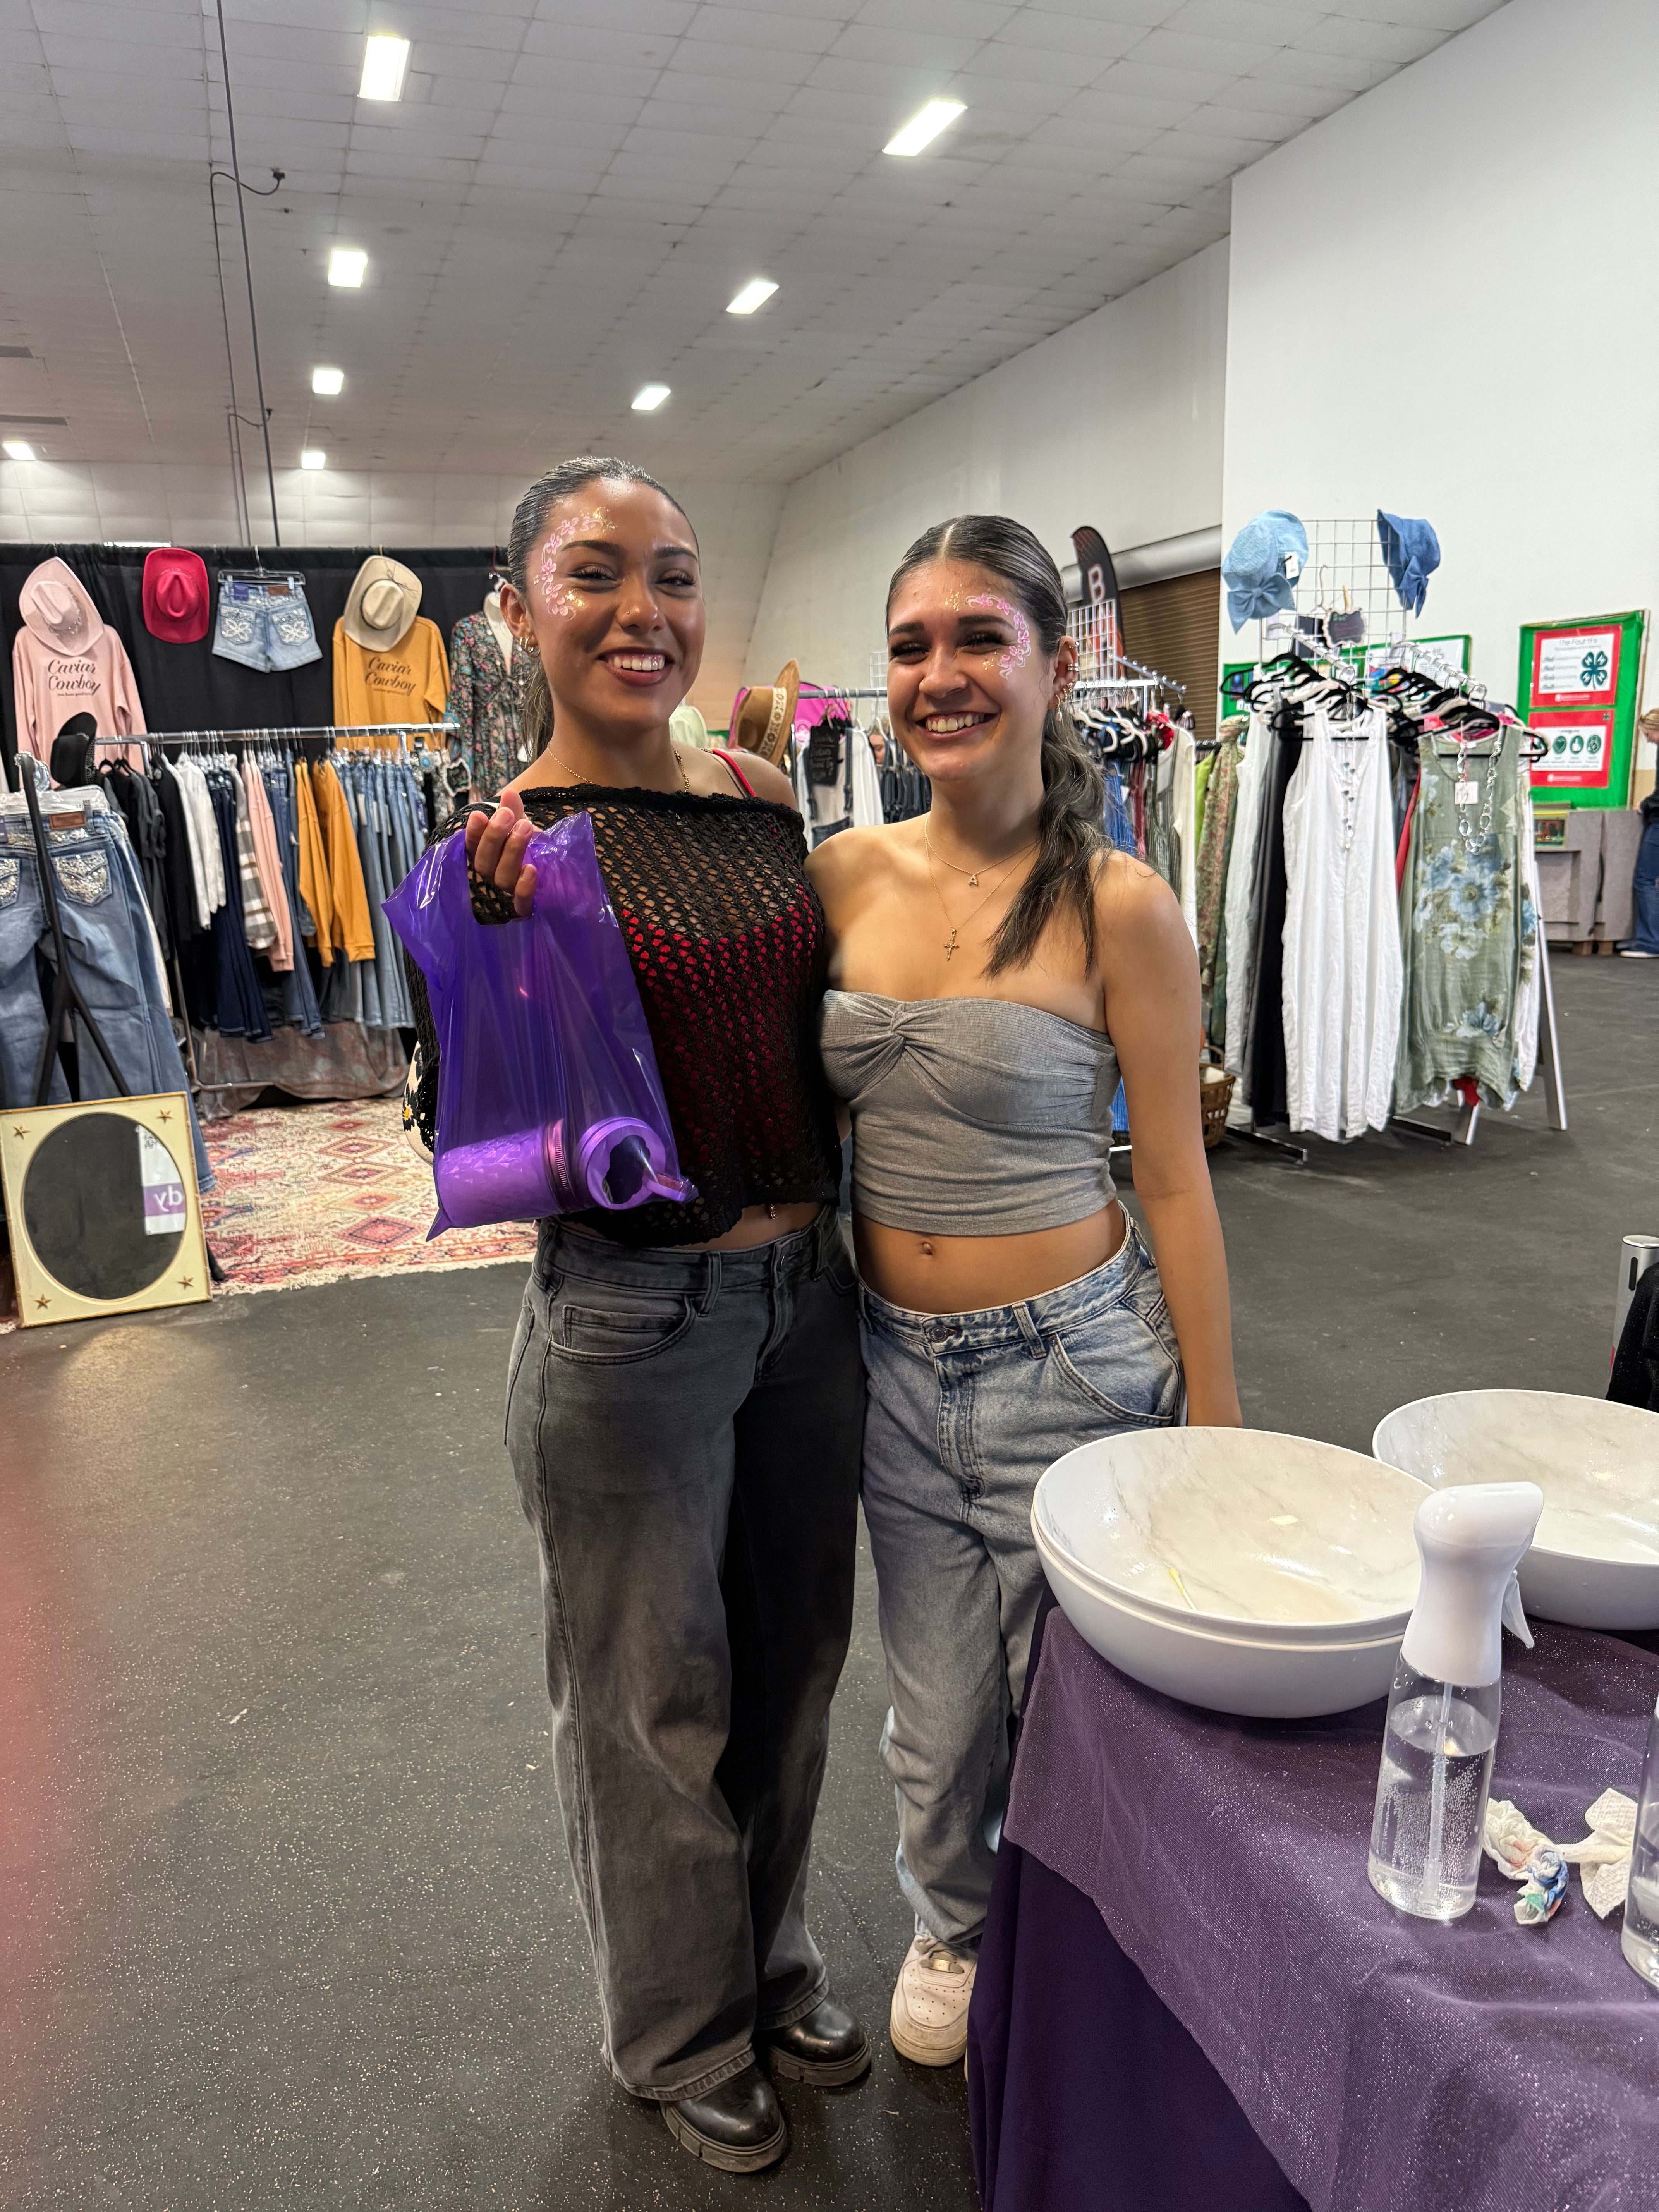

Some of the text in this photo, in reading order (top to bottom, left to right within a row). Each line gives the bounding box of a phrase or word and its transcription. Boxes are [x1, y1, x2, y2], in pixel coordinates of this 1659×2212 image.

[48, 659, 96, 675] Caviar
[368, 656, 412, 675] Caviar
[48, 674, 101, 696] Cowboy
[365, 672, 417, 696] Cowboy
